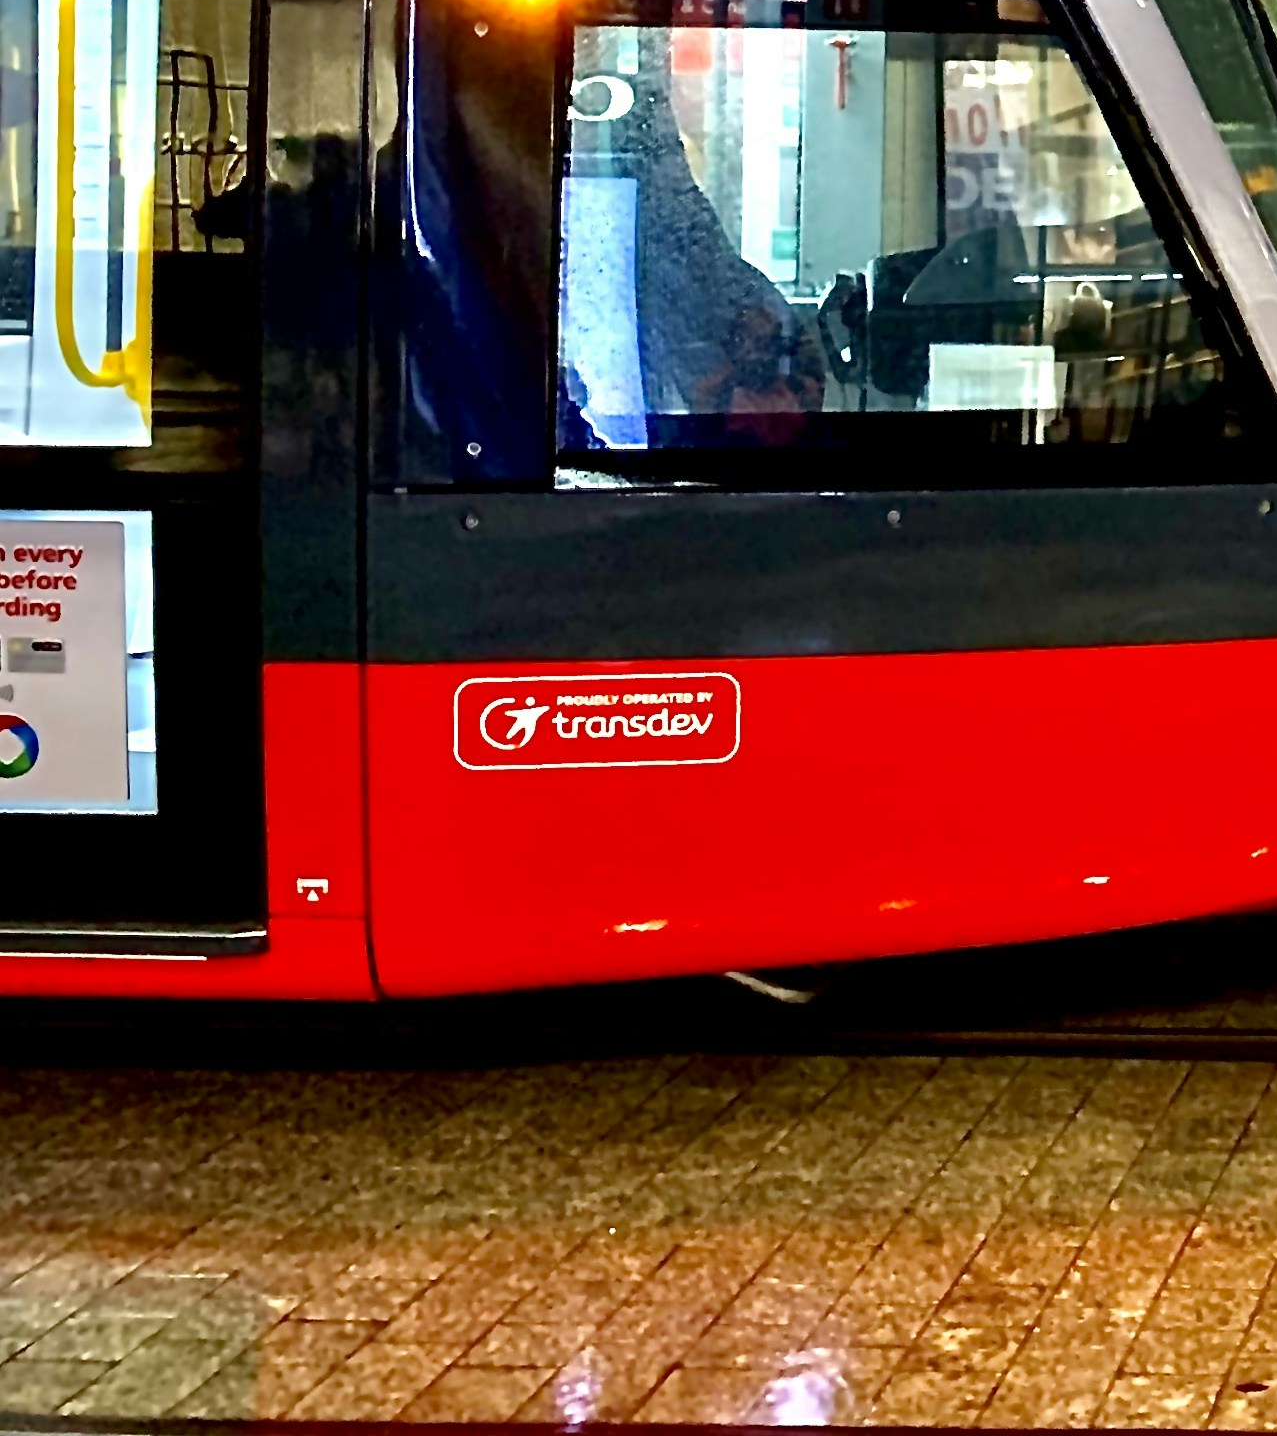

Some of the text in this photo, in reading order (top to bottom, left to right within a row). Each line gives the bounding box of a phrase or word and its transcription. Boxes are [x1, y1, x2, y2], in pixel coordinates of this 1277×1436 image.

[13, 547, 84, 569] every
[556, 692, 713, 706] PROUDLY OPERATED BY
[551, 707, 714, 739] transdev
